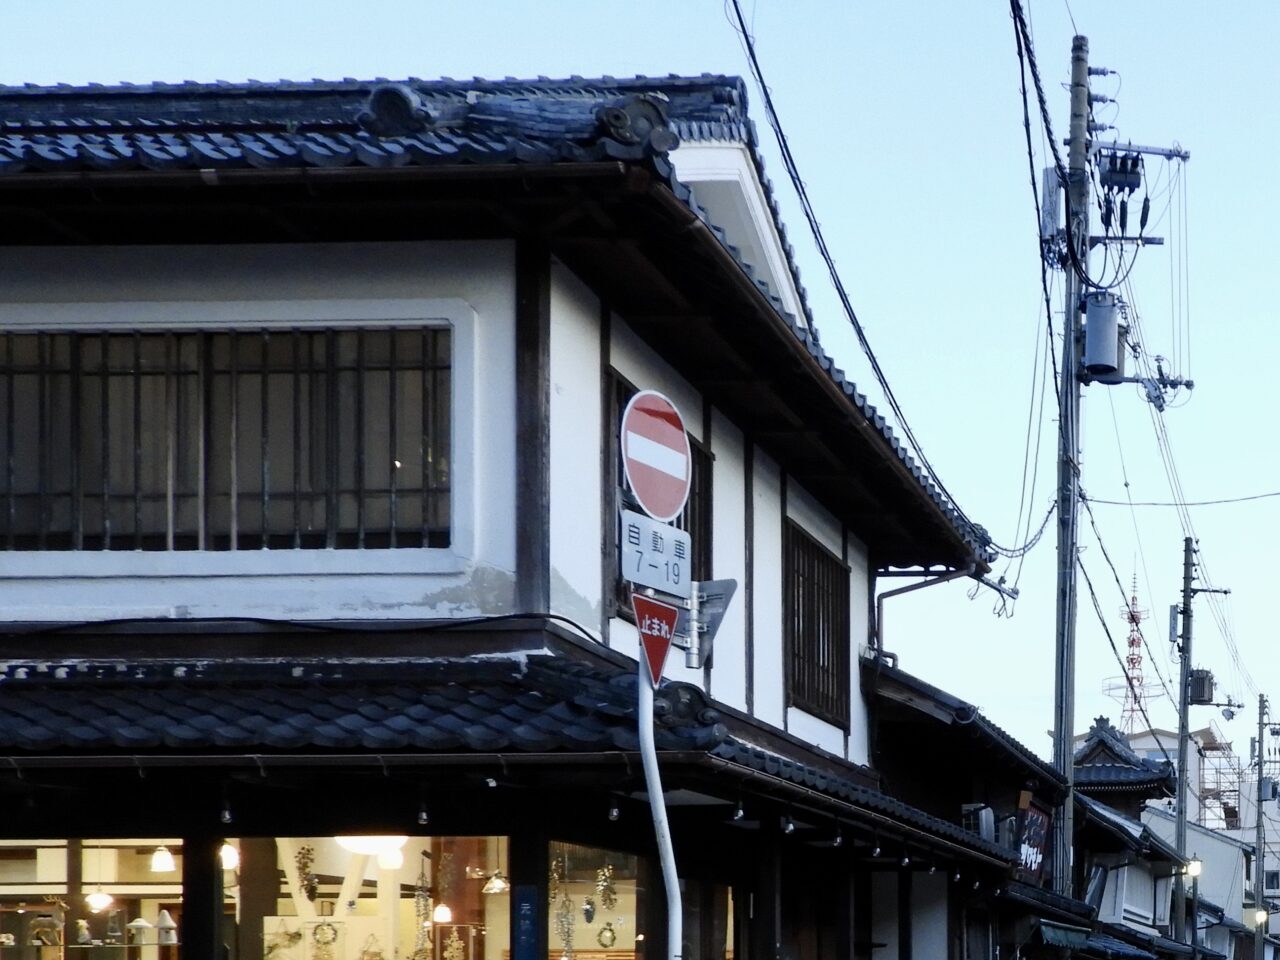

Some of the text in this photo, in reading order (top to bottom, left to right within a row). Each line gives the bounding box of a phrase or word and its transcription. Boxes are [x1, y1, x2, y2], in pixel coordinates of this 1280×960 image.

[628, 522, 686, 560] 自動車
[634, 550, 681, 585] 7-19
[641, 614, 671, 640] 止まれ
